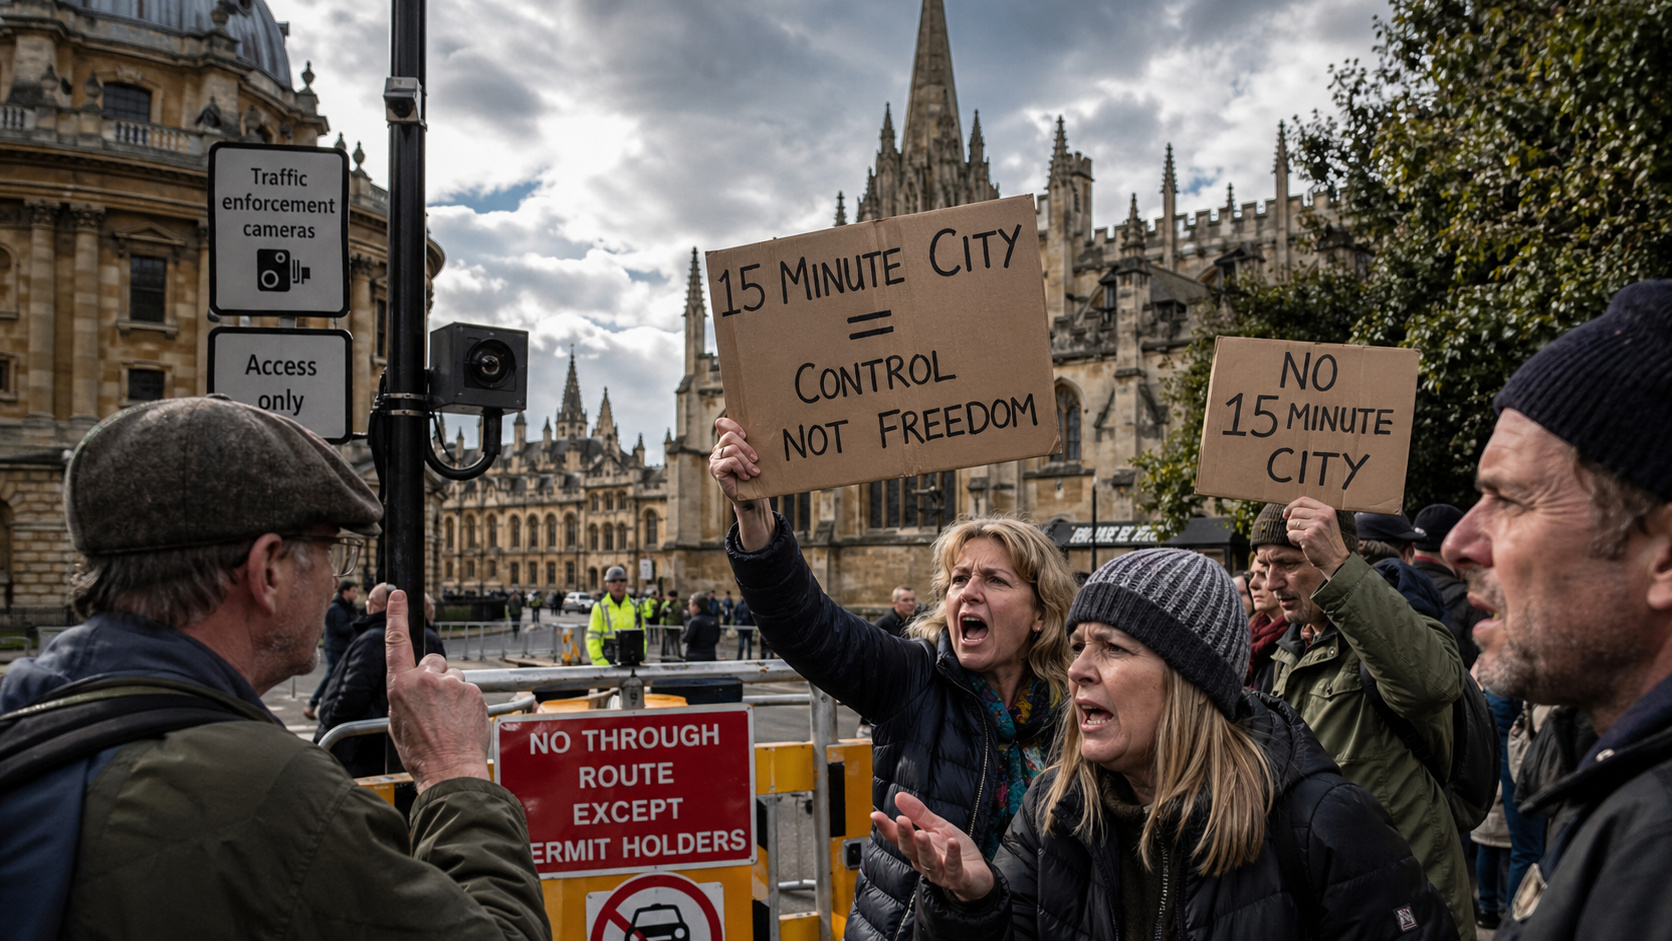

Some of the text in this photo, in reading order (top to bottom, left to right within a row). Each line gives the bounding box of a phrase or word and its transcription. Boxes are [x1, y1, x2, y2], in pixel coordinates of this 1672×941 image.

[250, 167, 308, 187] Traffic
[222, 193, 335, 214] enforcement
[242, 223, 316, 239] cameras
[718, 223, 1022, 318] 15 MINUTE CITY
[846, 309, 895, 341] =
[244, 353, 317, 376] Access
[794, 350, 957, 404] CONTROL
[1279, 351, 1338, 392] NO
[258, 388, 304, 416] only
[1222, 392, 1395, 438] 15 MINUTE
[782, 393, 1039, 462] NOT FREEDOM
[1266, 447, 1371, 491] CITY
[529, 723, 720, 755] NO THROUGH
[578, 761, 675, 789] ROUTE
[573, 797, 684, 826] EXCEPT
[529, 828, 747, 865] ERMIT HOLDERS
